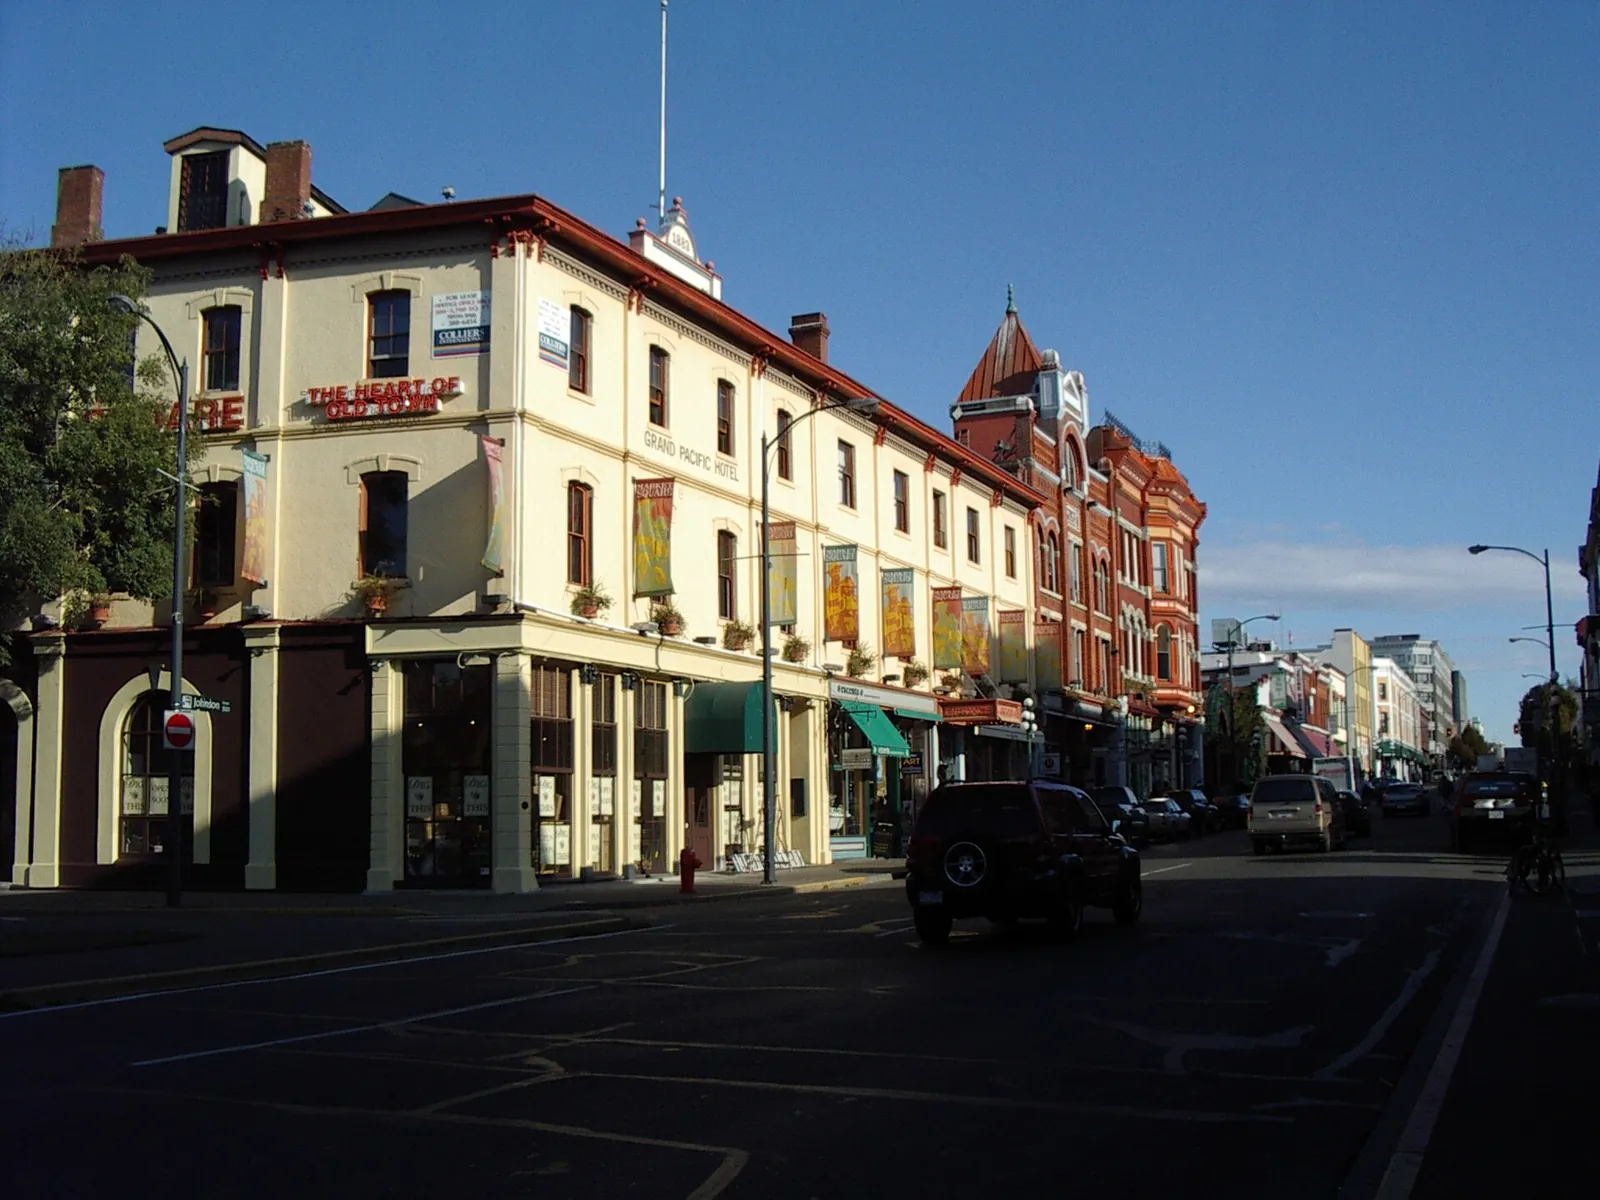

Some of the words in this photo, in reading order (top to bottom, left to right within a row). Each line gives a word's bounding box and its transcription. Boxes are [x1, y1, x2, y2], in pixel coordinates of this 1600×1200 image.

[439, 328, 485, 340] COLLIERS
[307, 386, 348, 405] THE
[355, 378, 425, 399] HEART
[431, 376, 460, 394] OF
[326, 399, 368, 419] OLD
[375, 394, 438, 414] TOWN
[644, 430, 676, 457] GRAND
[679, 445, 711, 471] PACIFIC
[714, 459, 739, 482] HOTEL
[193, 696, 220, 710] Johnson
